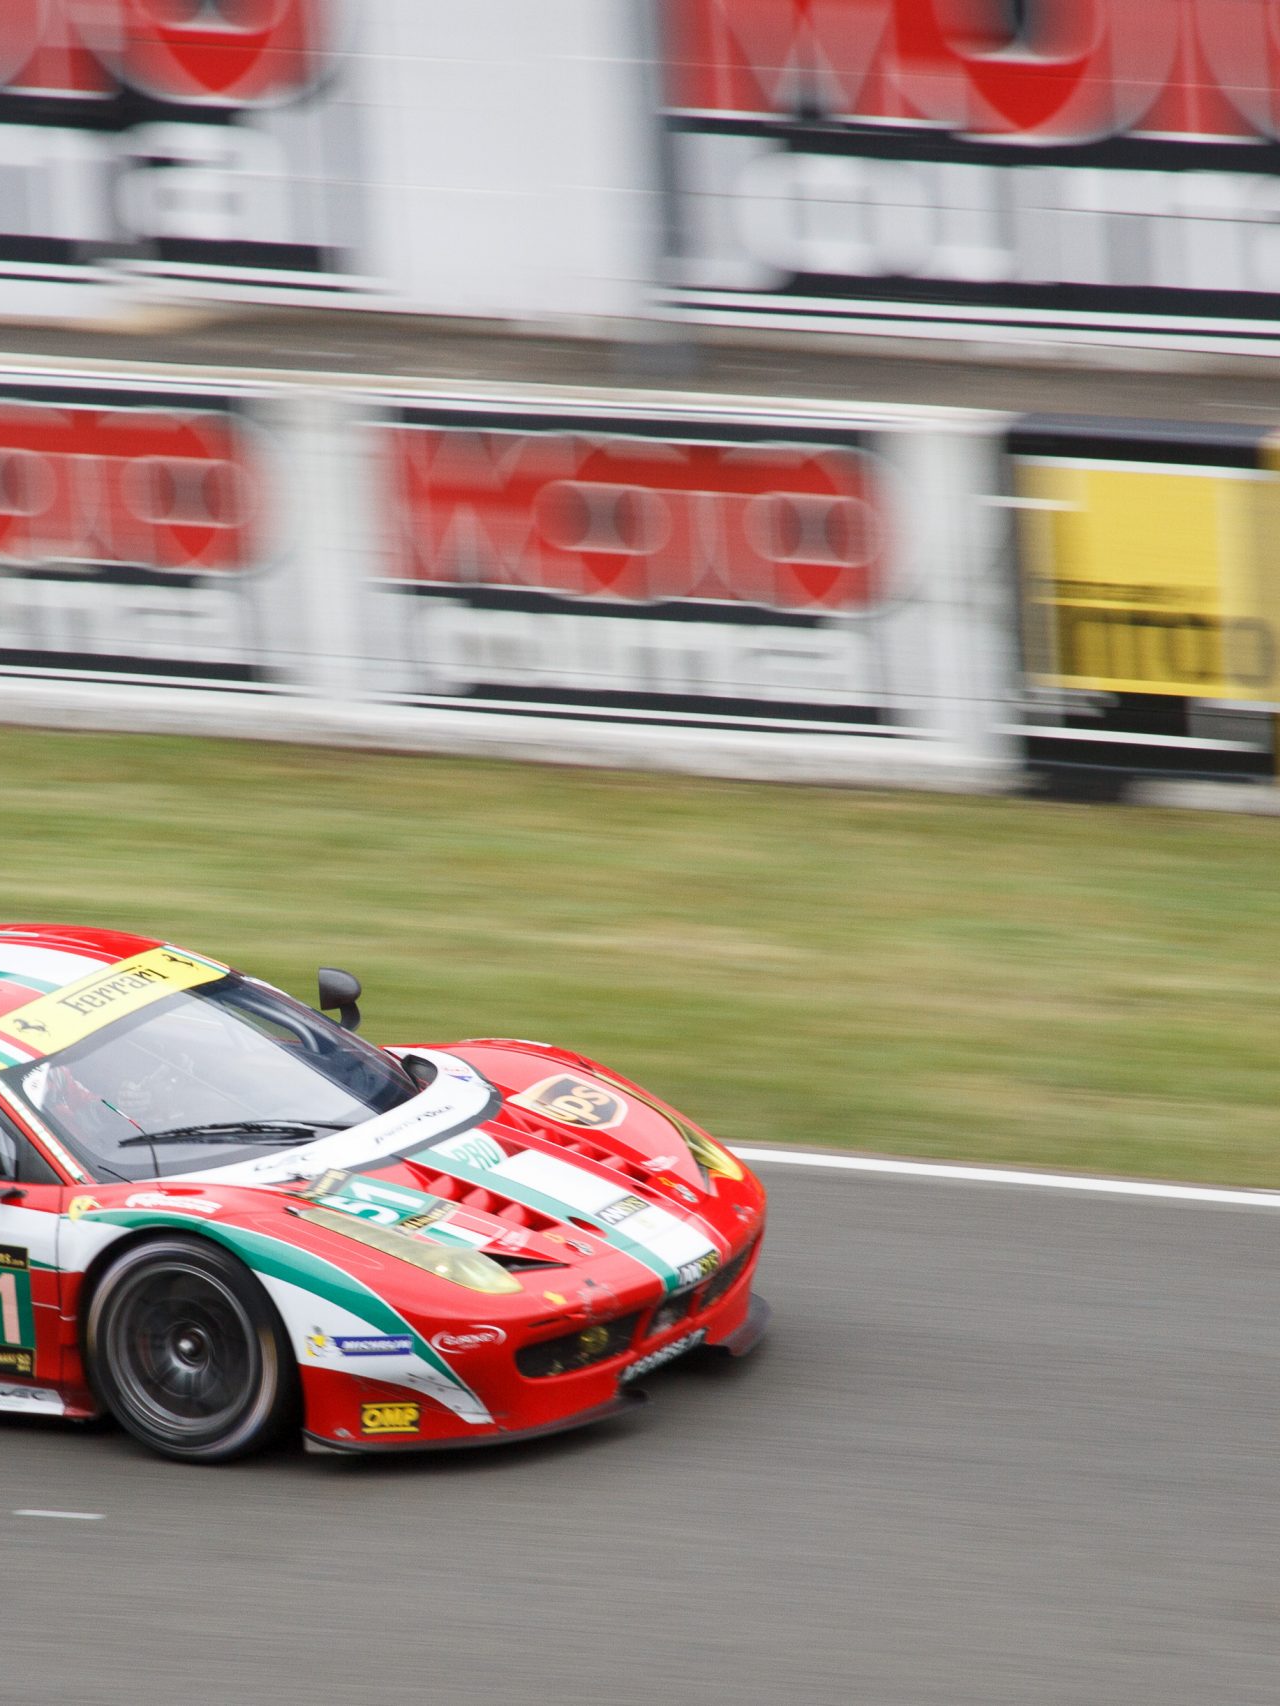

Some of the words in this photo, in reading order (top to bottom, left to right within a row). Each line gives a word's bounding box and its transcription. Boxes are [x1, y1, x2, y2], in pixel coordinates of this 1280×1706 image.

[57, 964, 170, 1016] Ferrari
[535, 1086, 612, 1122] ups
[361, 1407, 420, 1428] OMP
